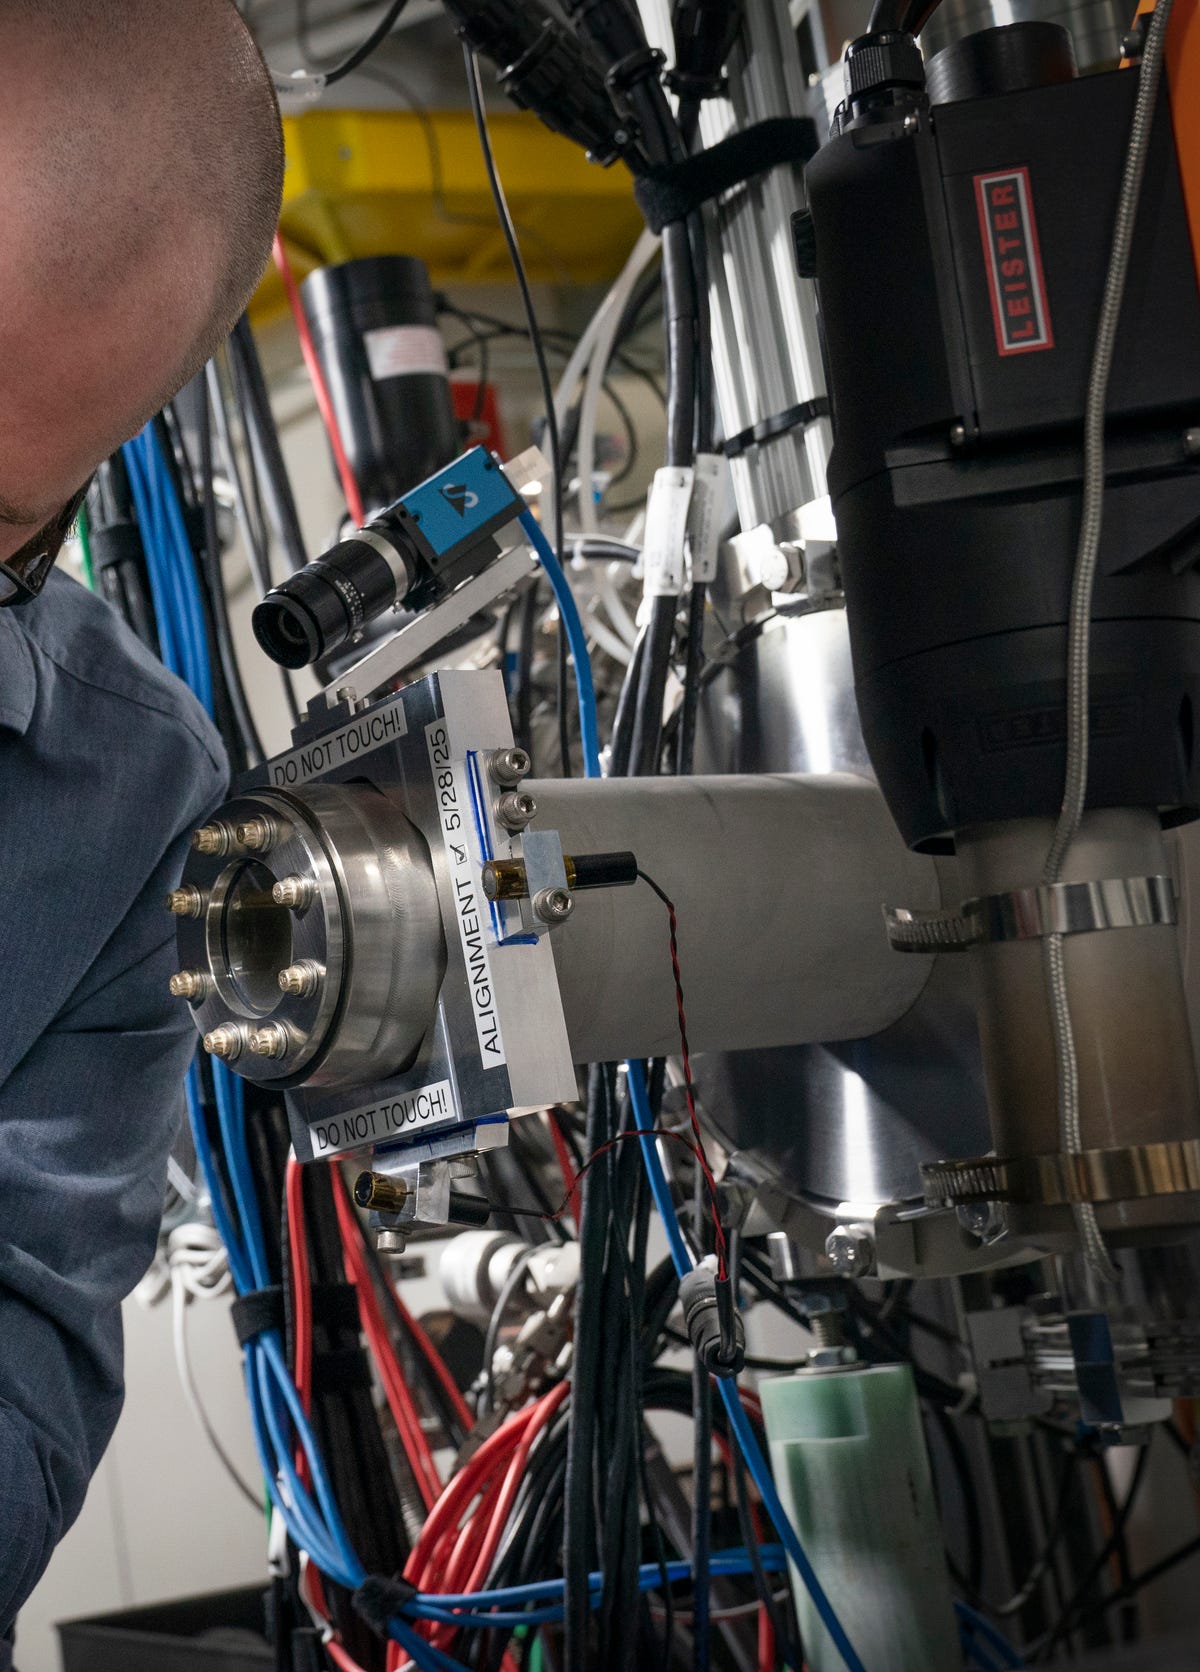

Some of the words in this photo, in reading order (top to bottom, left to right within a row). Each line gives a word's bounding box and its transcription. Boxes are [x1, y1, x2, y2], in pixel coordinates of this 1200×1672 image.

[991, 184, 1035, 339] LEISTER
[274, 760, 298, 785] DO
[301, 741, 332, 777] NOT
[336, 708, 401, 758] TOUCH!
[430, 728, 461, 831] 5/28/25
[455, 877, 501, 1055] ALIGNMENT
[316, 1122, 341, 1150] DO
[343, 1110, 377, 1142] NOT
[381, 1088, 448, 1130] TOUCH!
